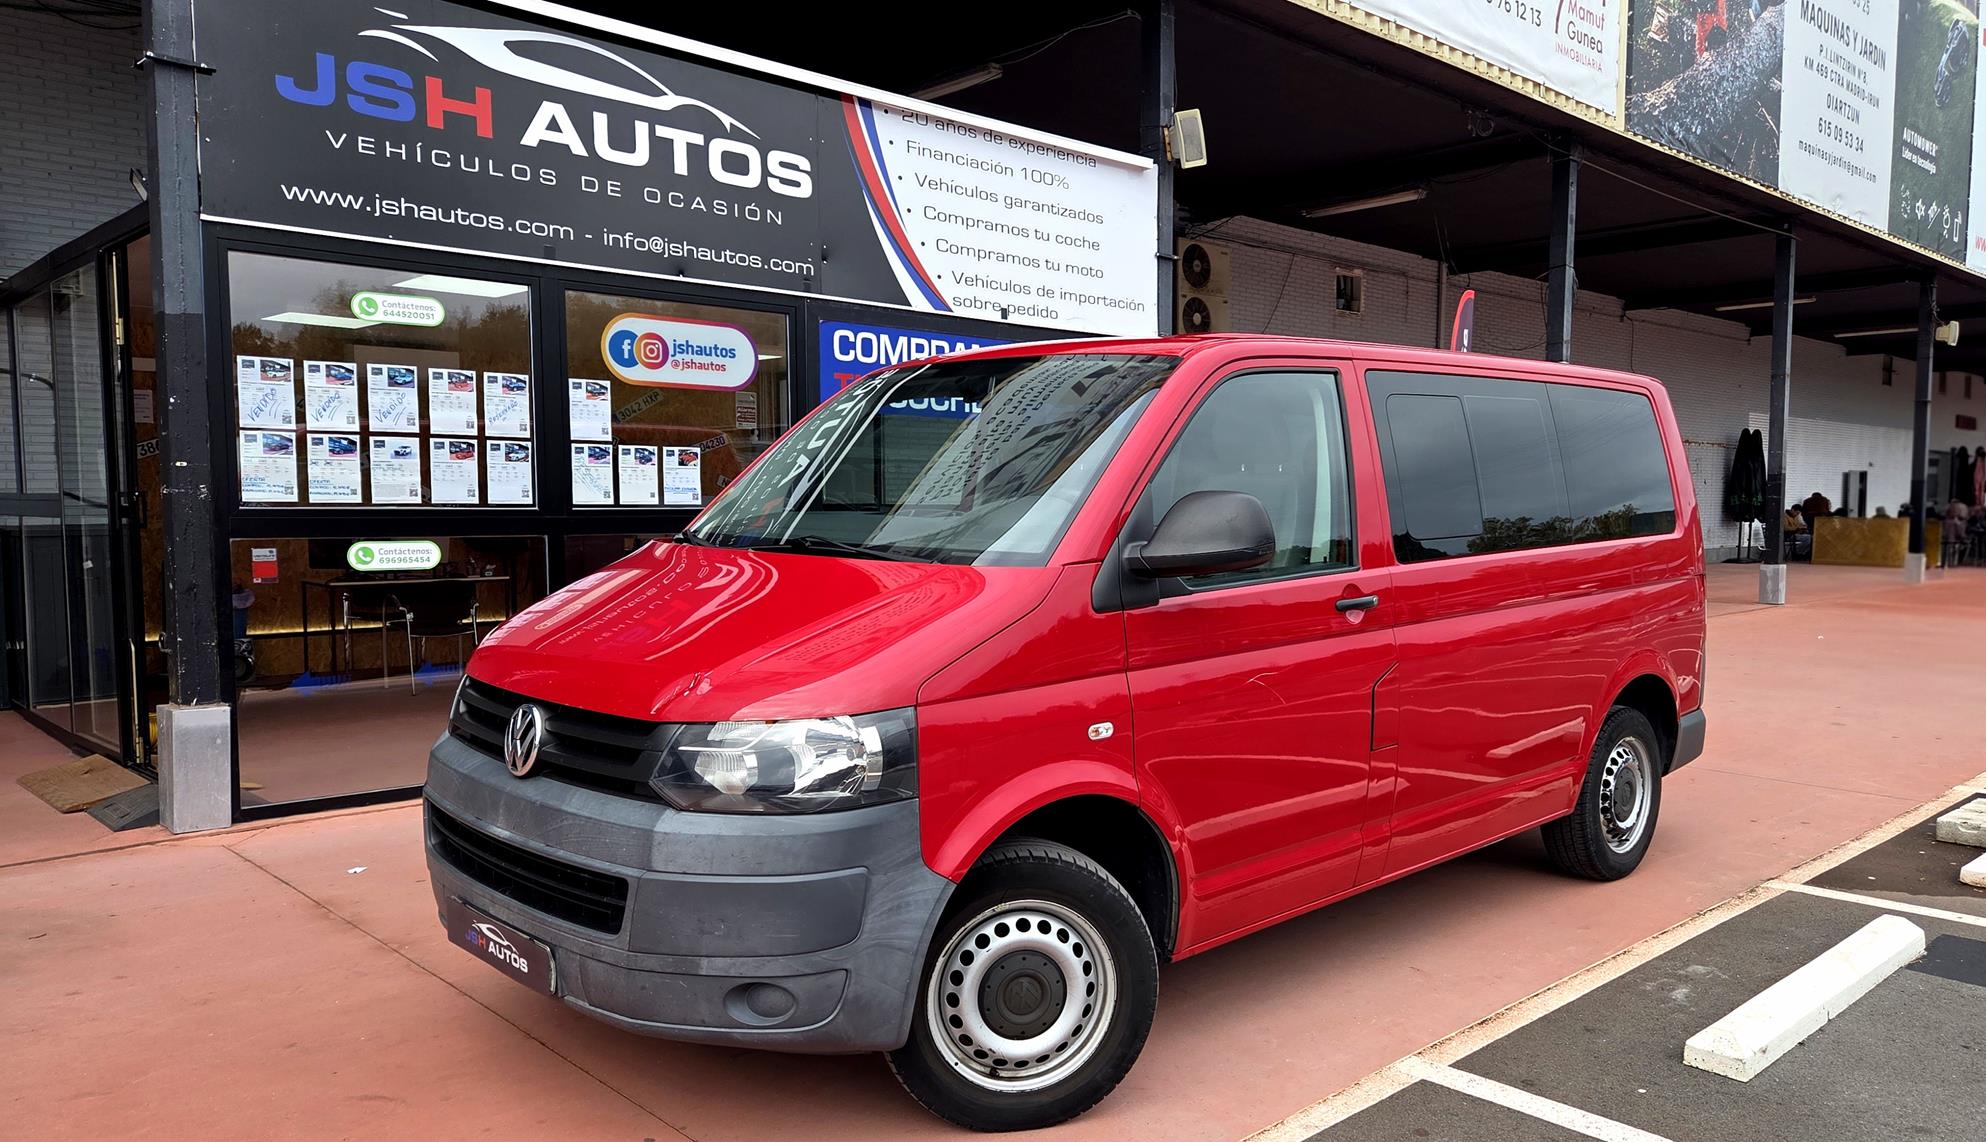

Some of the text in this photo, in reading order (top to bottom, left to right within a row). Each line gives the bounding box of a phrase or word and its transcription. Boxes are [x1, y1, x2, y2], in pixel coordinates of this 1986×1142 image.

[1515, 1, 1527, 20] 12
[1530, 7, 1542, 27] 13
[1568, 0, 1606, 31] Mamut
[1567, 20, 1603, 54] Gunea
[1800, 0, 1886, 72] MAQUINAS Y JARDIN
[1555, 42, 1603, 72] INMOBILIARIA
[1803, 55, 1814, 71] KM
[1830, 68, 1845, 89] CTRA
[275, 52, 493, 139] JSH
[1826, 92, 1860, 125] OIARTZUN
[519, 100, 813, 199] AUTOS
[935, 119, 977, 139] años
[983, 129, 1003, 146] de
[1008, 136, 1097, 168] experiencia
[1817, 116, 1864, 153] 615 09 53 34
[325, 130, 783, 225] VEHÍCULOS DE OCASIÓN
[906, 139, 1070, 191] Financiación 100%
[915, 172, 1104, 225] Vehículos garantizados
[280, 184, 575, 241] www.jshautos.com
[603, 228, 814, 277] info@jshautos.com
[923, 205, 1101, 251] Compramos tu coche
[935, 238, 1104, 279] Compramos tu moto
[381, 300, 437, 312] Contáctenos:
[951, 270, 1145, 313] Vehículos de importación
[952, 295, 1060, 320] sobre pedido
[383, 309, 435, 320] 644520051
[671, 339, 737, 358] jshautos
[671, 358, 727, 372] @jshautos
[248, 387, 277, 421] VENDIDO
[311, 392, 341, 422] VENDIDO
[375, 392, 406, 423] VENDIDO
[378, 547, 433, 556] Contáctenos:
[379, 556, 431, 564] 696965454
[488, 941, 528, 973] AUTOS
